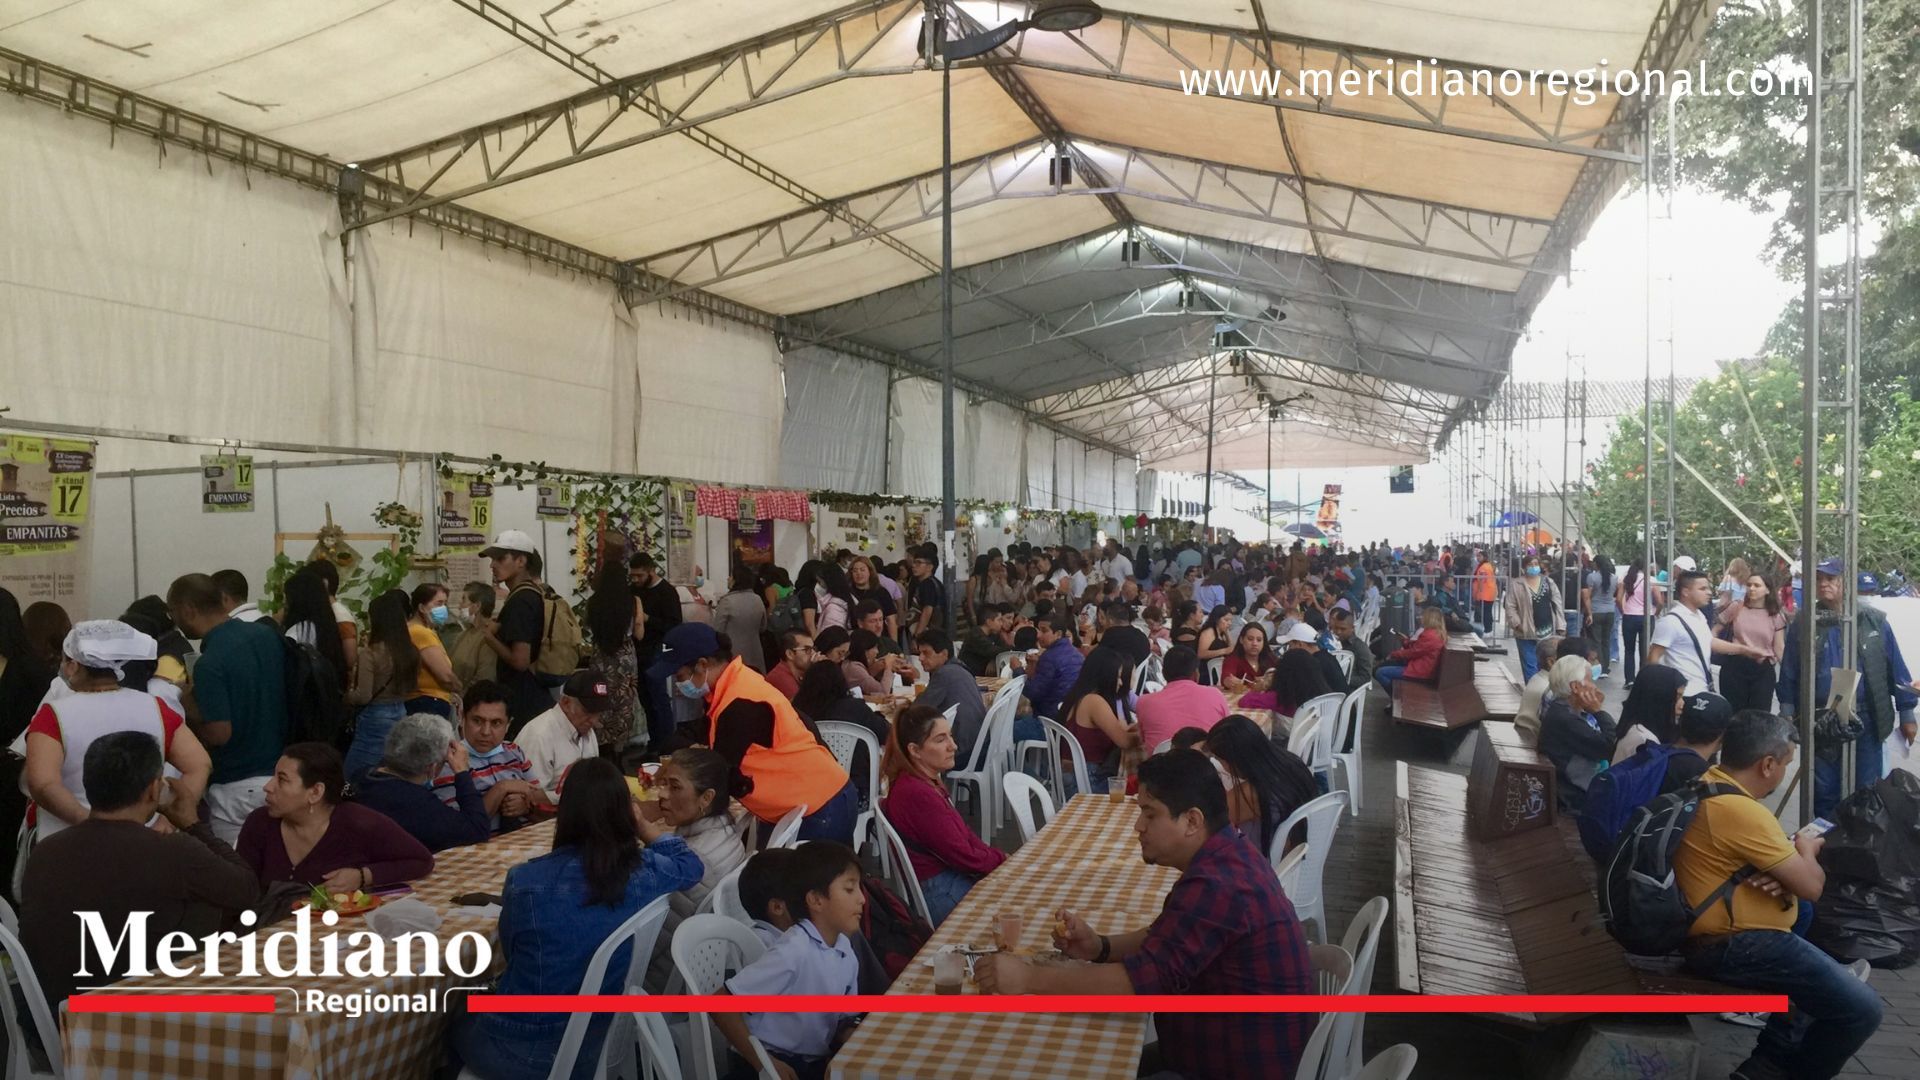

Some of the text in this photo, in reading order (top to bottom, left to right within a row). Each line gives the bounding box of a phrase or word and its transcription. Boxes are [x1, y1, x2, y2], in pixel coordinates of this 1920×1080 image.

[238, 464, 251, 482] 17
[62, 476, 85, 485] stand
[58, 485, 83, 514] 17
[208, 493, 248, 504] EMPANITAS
[560, 487, 570, 501] 16
[0, 503, 39, 516] Precios
[473, 506, 487, 526] 16
[6, 526, 68, 540] EMPANITAS
